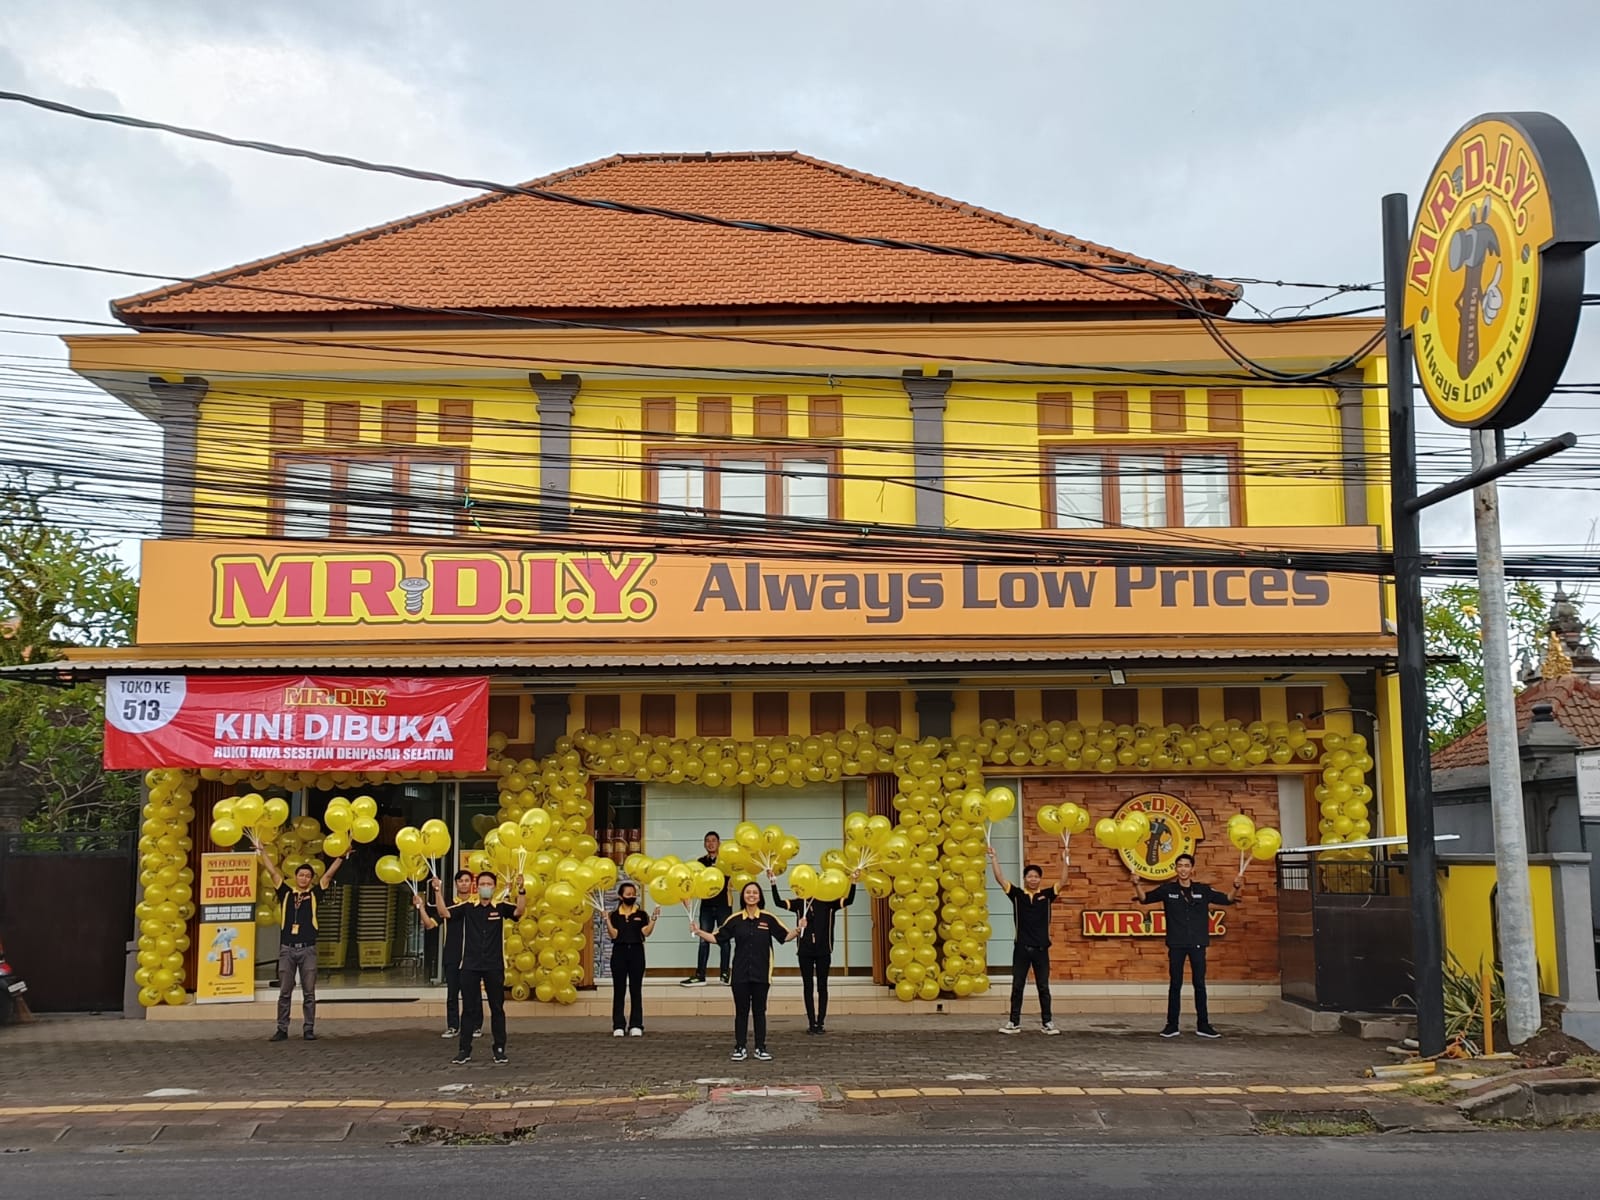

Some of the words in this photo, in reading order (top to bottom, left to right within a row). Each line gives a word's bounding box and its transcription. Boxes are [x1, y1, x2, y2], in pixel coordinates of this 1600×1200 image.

[1422, 333, 1460, 402] Always
[1463, 373, 1494, 403] Low
[1495, 276, 1529, 376] Prices
[693, 562, 944, 624] Always
[962, 563, 1097, 609] Low
[1114, 566, 1330, 608] Prices
[120, 680, 152, 694] TOKO
[155, 681, 171, 694] KE
[122, 699, 160, 721] 513
[213, 713, 293, 741] KINI
[303, 714, 453, 743] DIBUKA
[213, 746, 247, 759] RUKO
[250, 746, 281, 760] RAYA
[283, 746, 334, 760] SESETAN
[336, 747, 401, 761] DENPASAR
[403, 748, 454, 762] SELATAN
[210, 875, 249, 887] TELAH
[205, 886, 252, 899] DIBUKA
